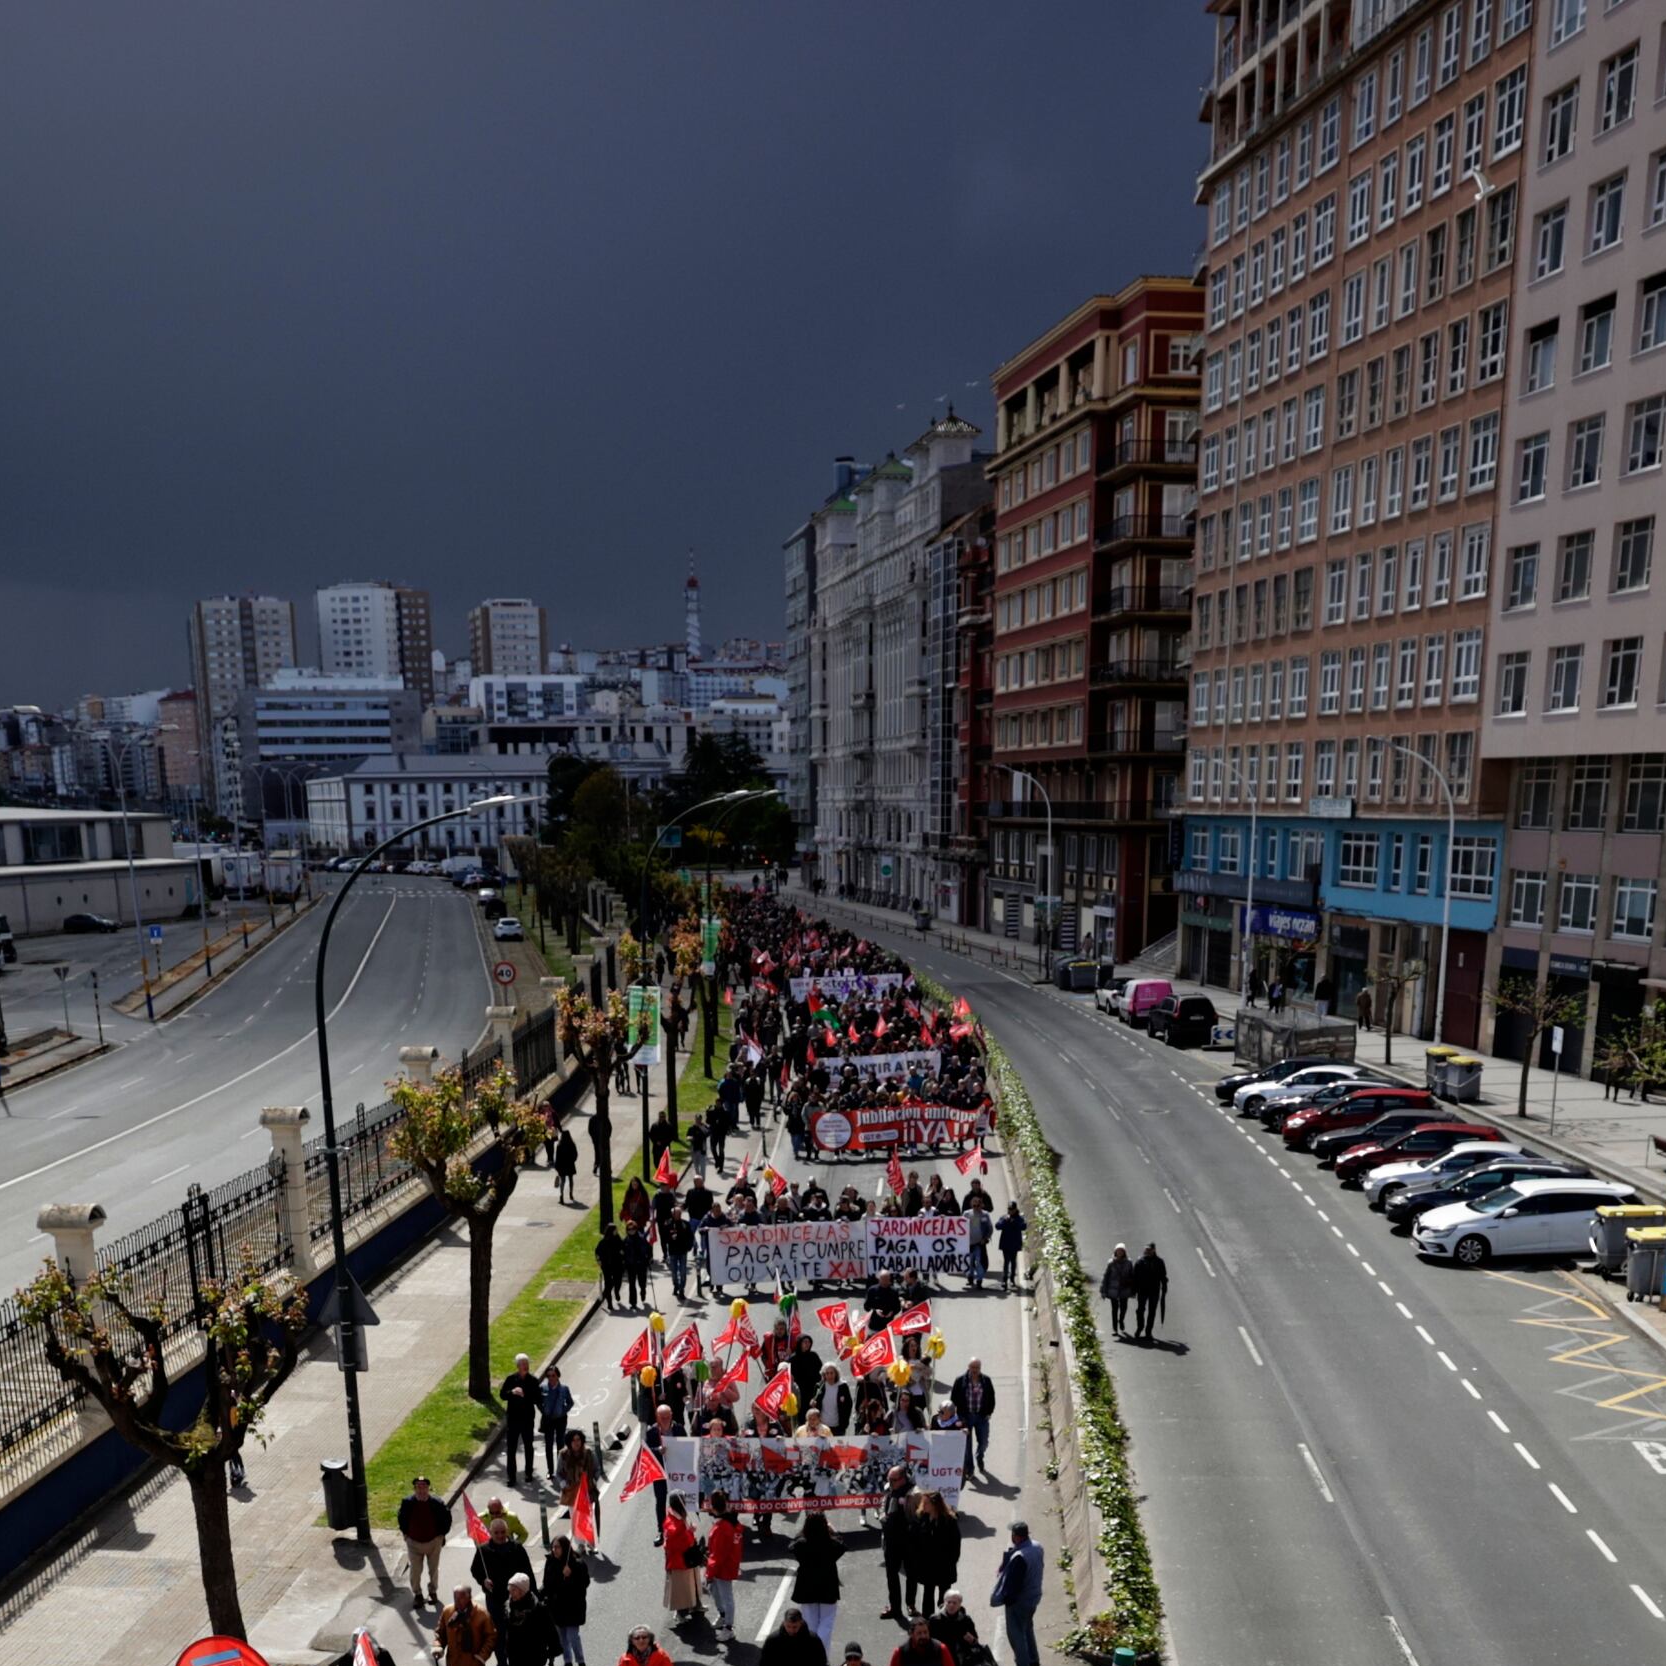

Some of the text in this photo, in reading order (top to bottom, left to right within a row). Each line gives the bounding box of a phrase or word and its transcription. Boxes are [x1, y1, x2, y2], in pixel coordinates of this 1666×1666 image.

[724, 1244, 783, 1267] PAGA
[803, 1239, 866, 1261] CUMPRE
[875, 1237, 958, 1254] PAGA OS
[727, 1266, 755, 1283] OU
[931, 1467, 953, 1477] UGT
[834, 1495, 872, 1507] LIMPEZA
